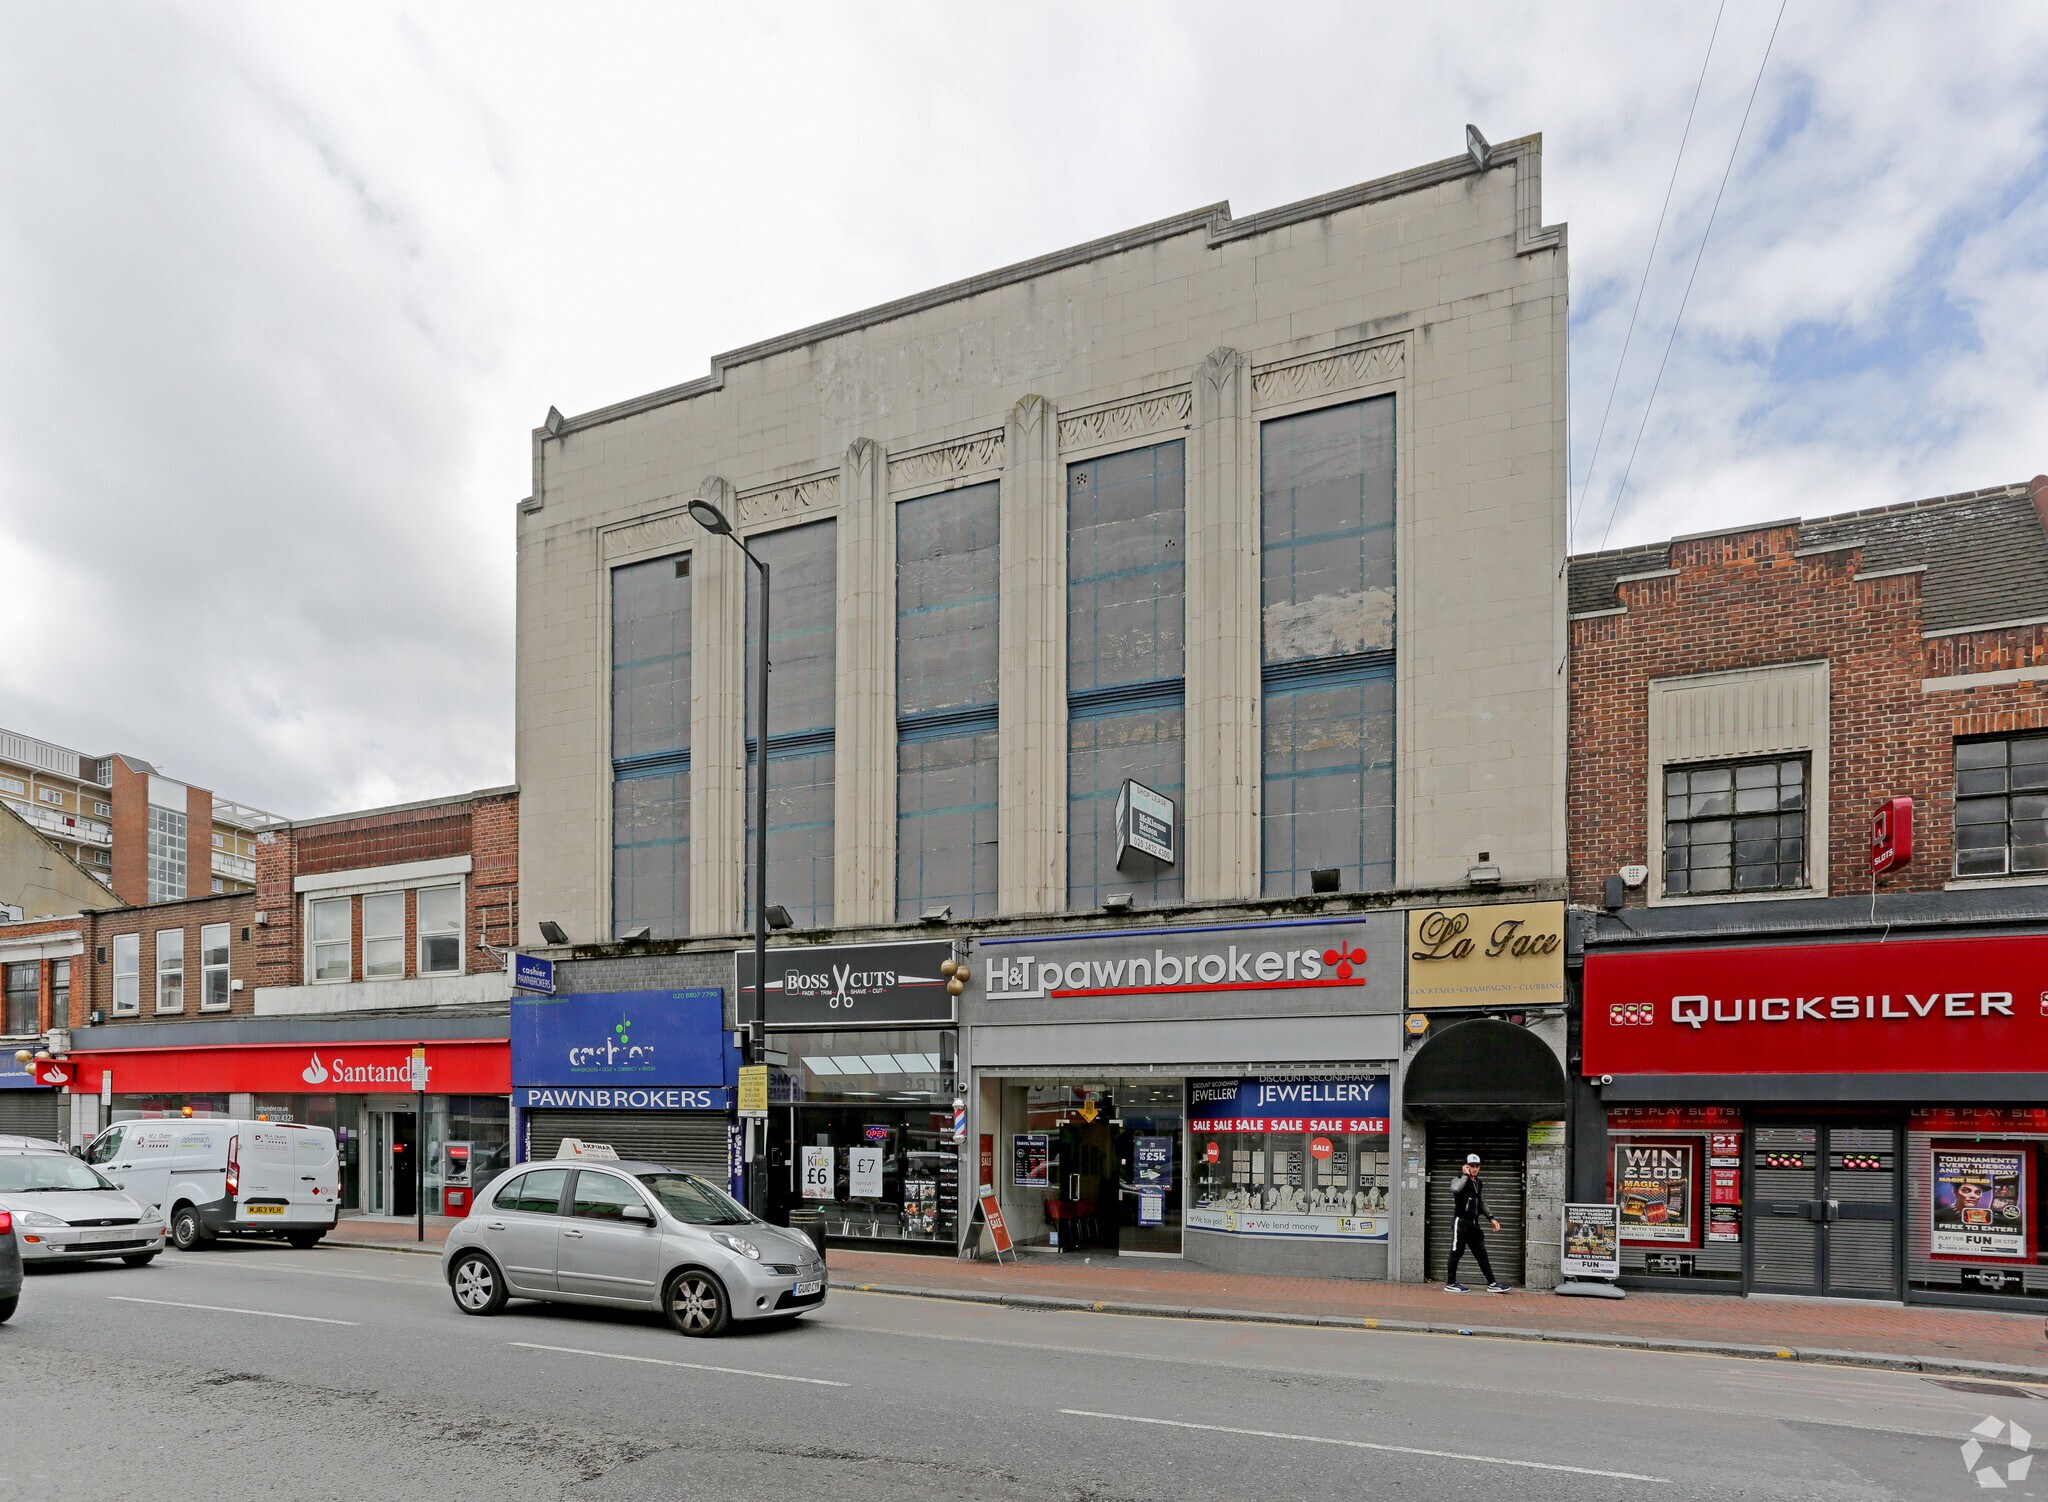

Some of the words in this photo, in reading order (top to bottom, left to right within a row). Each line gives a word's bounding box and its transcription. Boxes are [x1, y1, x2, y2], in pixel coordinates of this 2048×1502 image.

[1136, 786, 1150, 798] SHOP
[1152, 795, 1167, 808] LEASE
[1874, 848, 1894, 866] SLOTS
[1412, 911, 1476, 961] La
[1484, 920, 1562, 958] Face
[522, 966, 546, 978] cashier
[1038, 945, 1322, 991] pawnbrokers
[518, 974, 550, 989] PAWNBROKERS
[786, 973, 828, 990] BOSS
[850, 970, 895, 988] CUTS
[1410, 986, 1455, 995] COCKTAILS
[1460, 984, 1513, 993] CHAMPAGNE
[1519, 982, 1563, 991] CLUBBING
[1671, 992, 2015, 1029] QUICKSILVER
[332, 1056, 432, 1083] Santandr
[528, 1090, 712, 1108] PAWNBROKERS
[1192, 1088, 1237, 1104] JEWELLERY
[1258, 1084, 1374, 1107] JEWELLERY
[1607, 1108, 1643, 1116] LET'S
[1649, 1108, 1682, 1116] PLAY
[1688, 1108, 1740, 1116] SLOTS!
[2012, 1109, 2048, 1117] SLO
[1193, 1121, 1210, 1131] SALE
[1214, 1121, 1232, 1131] SALE
[1236, 1120, 1264, 1131] SALE
[1270, 1120, 1303, 1131] SALE
[1310, 1120, 1342, 1131] SALE
[1350, 1120, 1383, 1132] SALE
[572, 1143, 582, 1154] L
[1713, 1136, 1737, 1148] 21
[808, 1155, 829, 1167] Kids
[982, 1157, 992, 1166] SALE
[1146, 1152, 1165, 1161] £5k
[1625, 1150, 1682, 1167] WIN
[1939, 1156, 2018, 1164] TOURNAMENTS
[857, 1158, 875, 1173] £7
[807, 1168, 827, 1184] £6
[1624, 1167, 1682, 1180] £500
[1624, 1180, 1660, 1188] MAGIC
[990, 1218, 1002, 1229] SALE
[1204, 1217, 1212, 1226] buy
[1212, 1218, 1222, 1226] gold
[1256, 1221, 1270, 1229] We
[1272, 1222, 1289, 1230] lend
[1291, 1224, 1319, 1232] money
[1966, 1236, 1992, 1244] FUN
